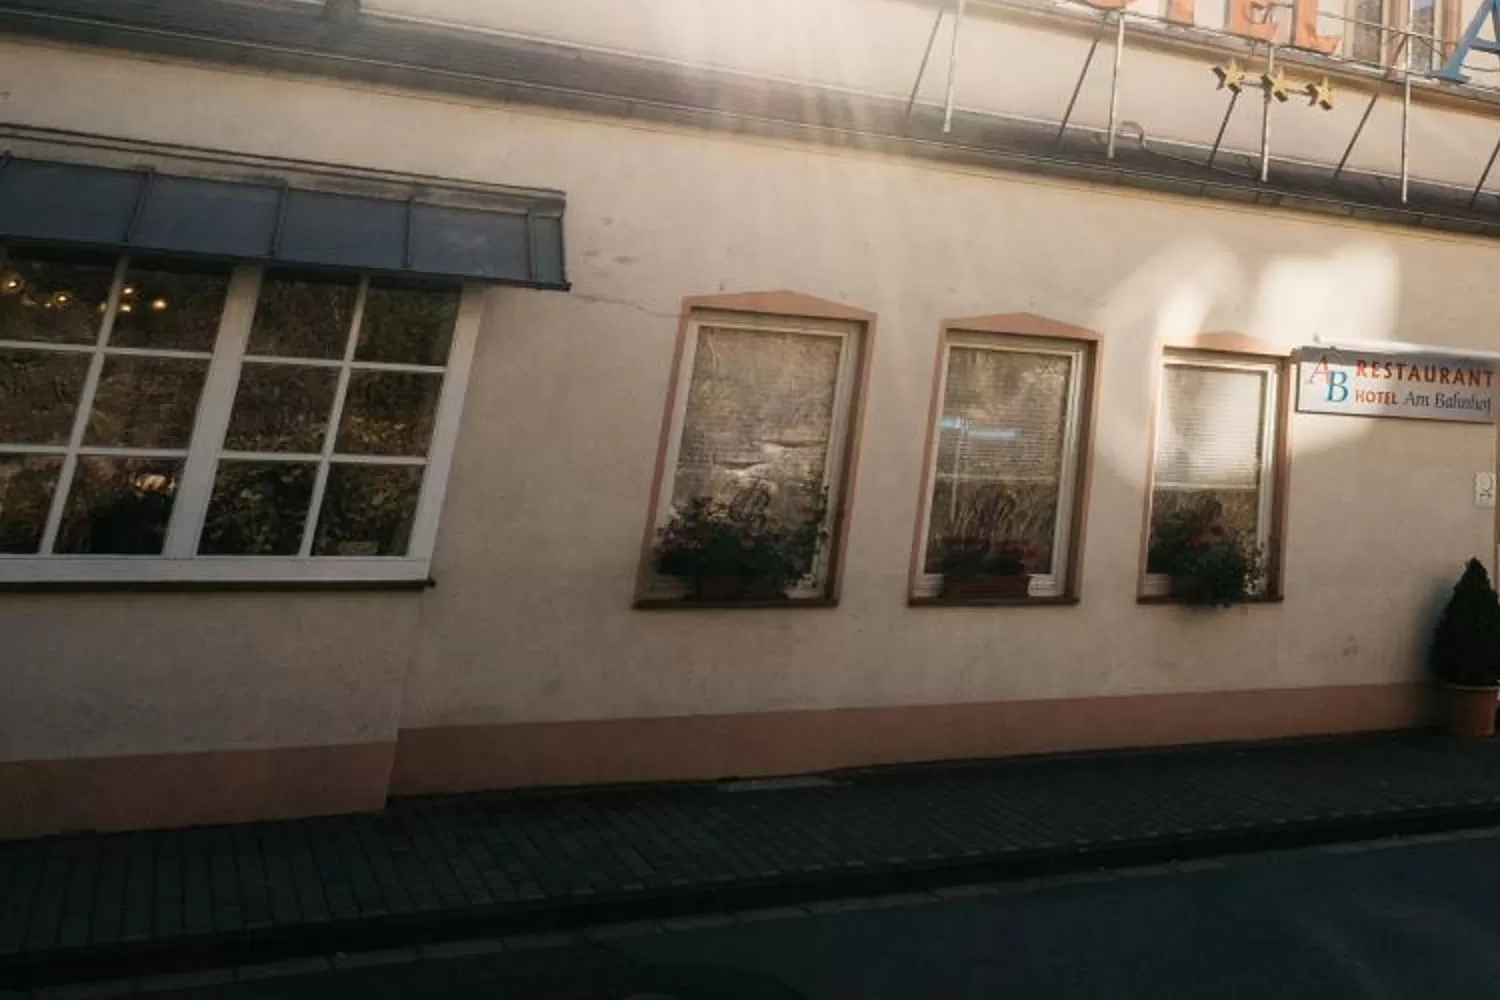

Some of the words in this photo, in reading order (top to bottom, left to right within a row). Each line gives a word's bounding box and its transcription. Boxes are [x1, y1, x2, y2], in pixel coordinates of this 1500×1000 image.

[1355, 358, 1494, 388] RESTAURANT
[1355, 389, 1398, 406] HOTEL
[1402, 391, 1430, 407] Am
[1434, 391, 1492, 413] Bahnhof
